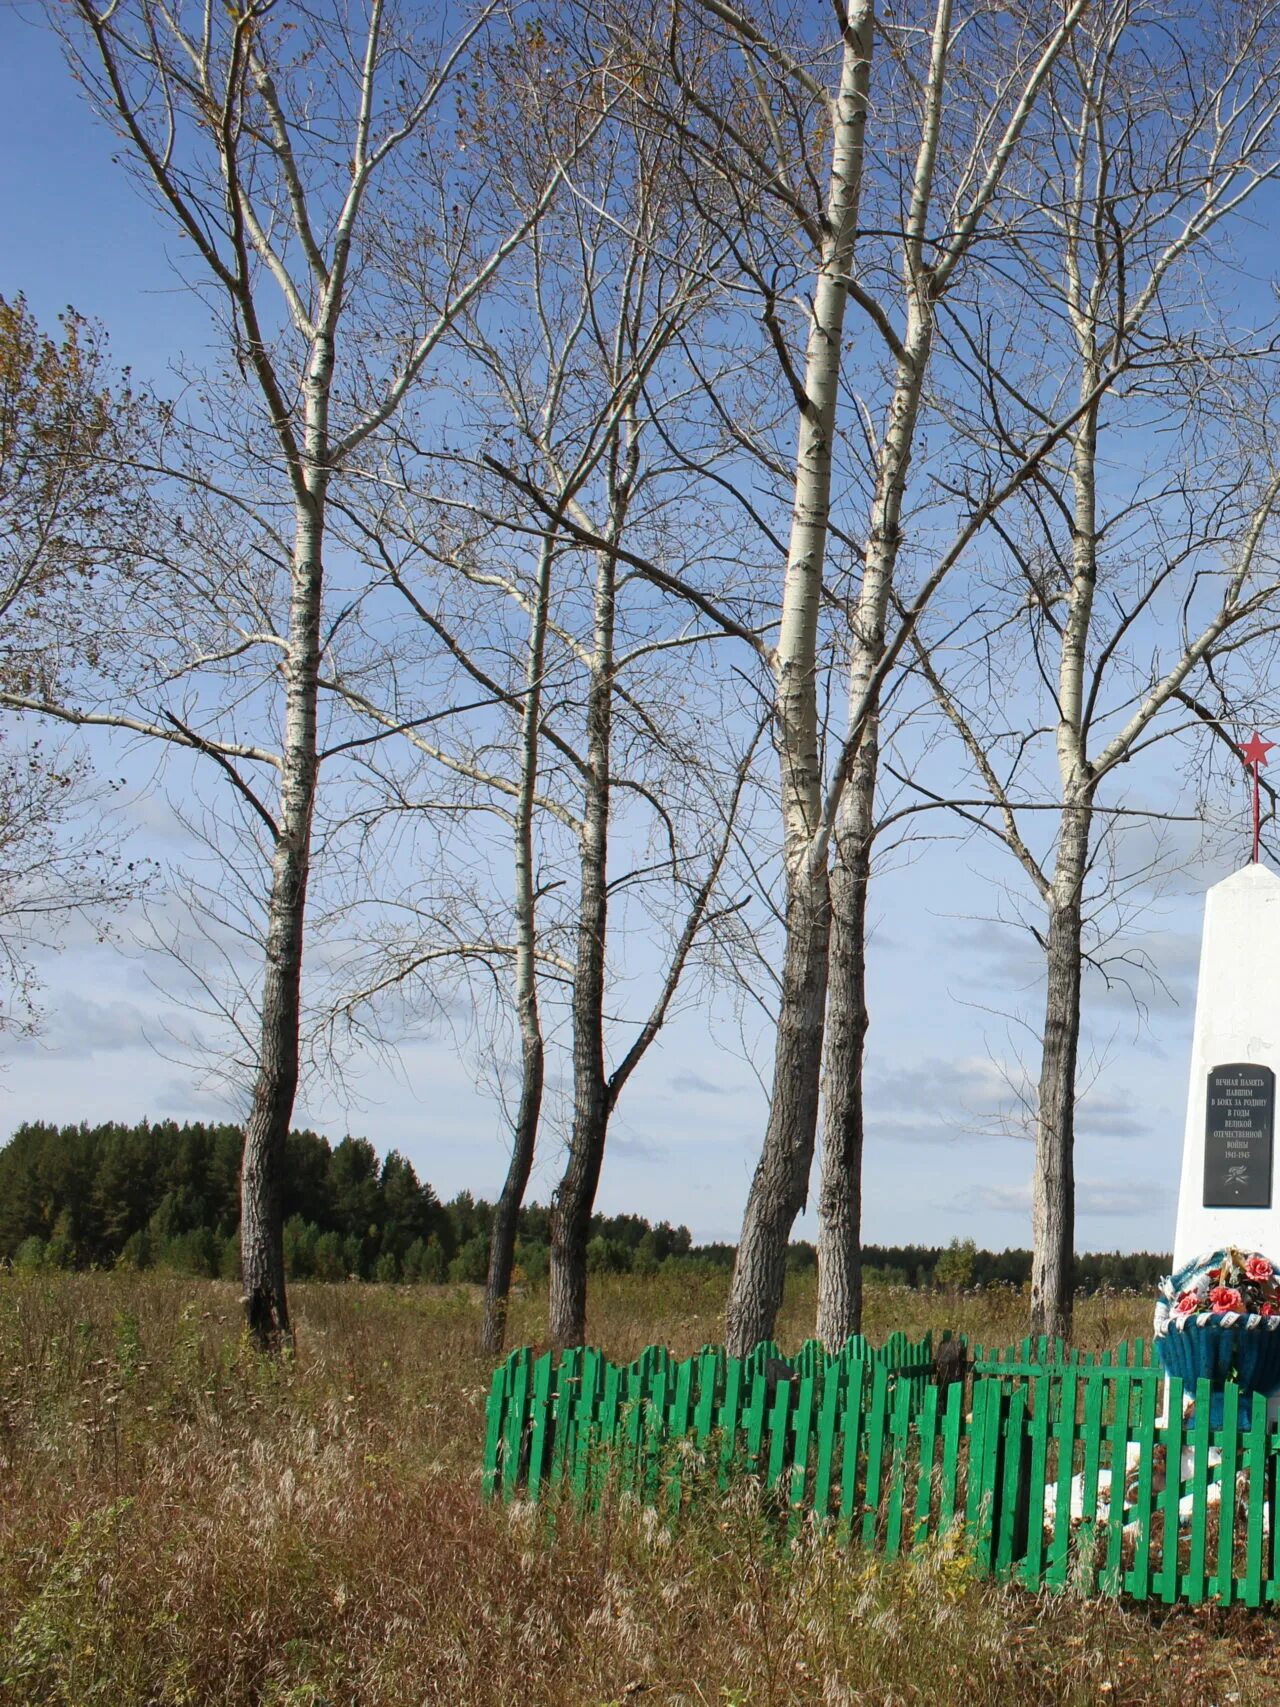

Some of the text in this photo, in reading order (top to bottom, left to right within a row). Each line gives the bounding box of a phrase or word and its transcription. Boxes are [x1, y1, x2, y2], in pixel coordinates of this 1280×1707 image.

[1215, 1078, 1265, 1086] ВЕЧНАЯ ПАМЯТЬ
[1233, 1109, 1250, 1117] ГОДЫ
[1224, 1119, 1252, 1127] ВЕЛИКОЙ
[1213, 1130, 1263, 1138] ОТЕЧЕСТВЕННОЙ
[1226, 1140, 1249, 1148] ВОЙНЫ
